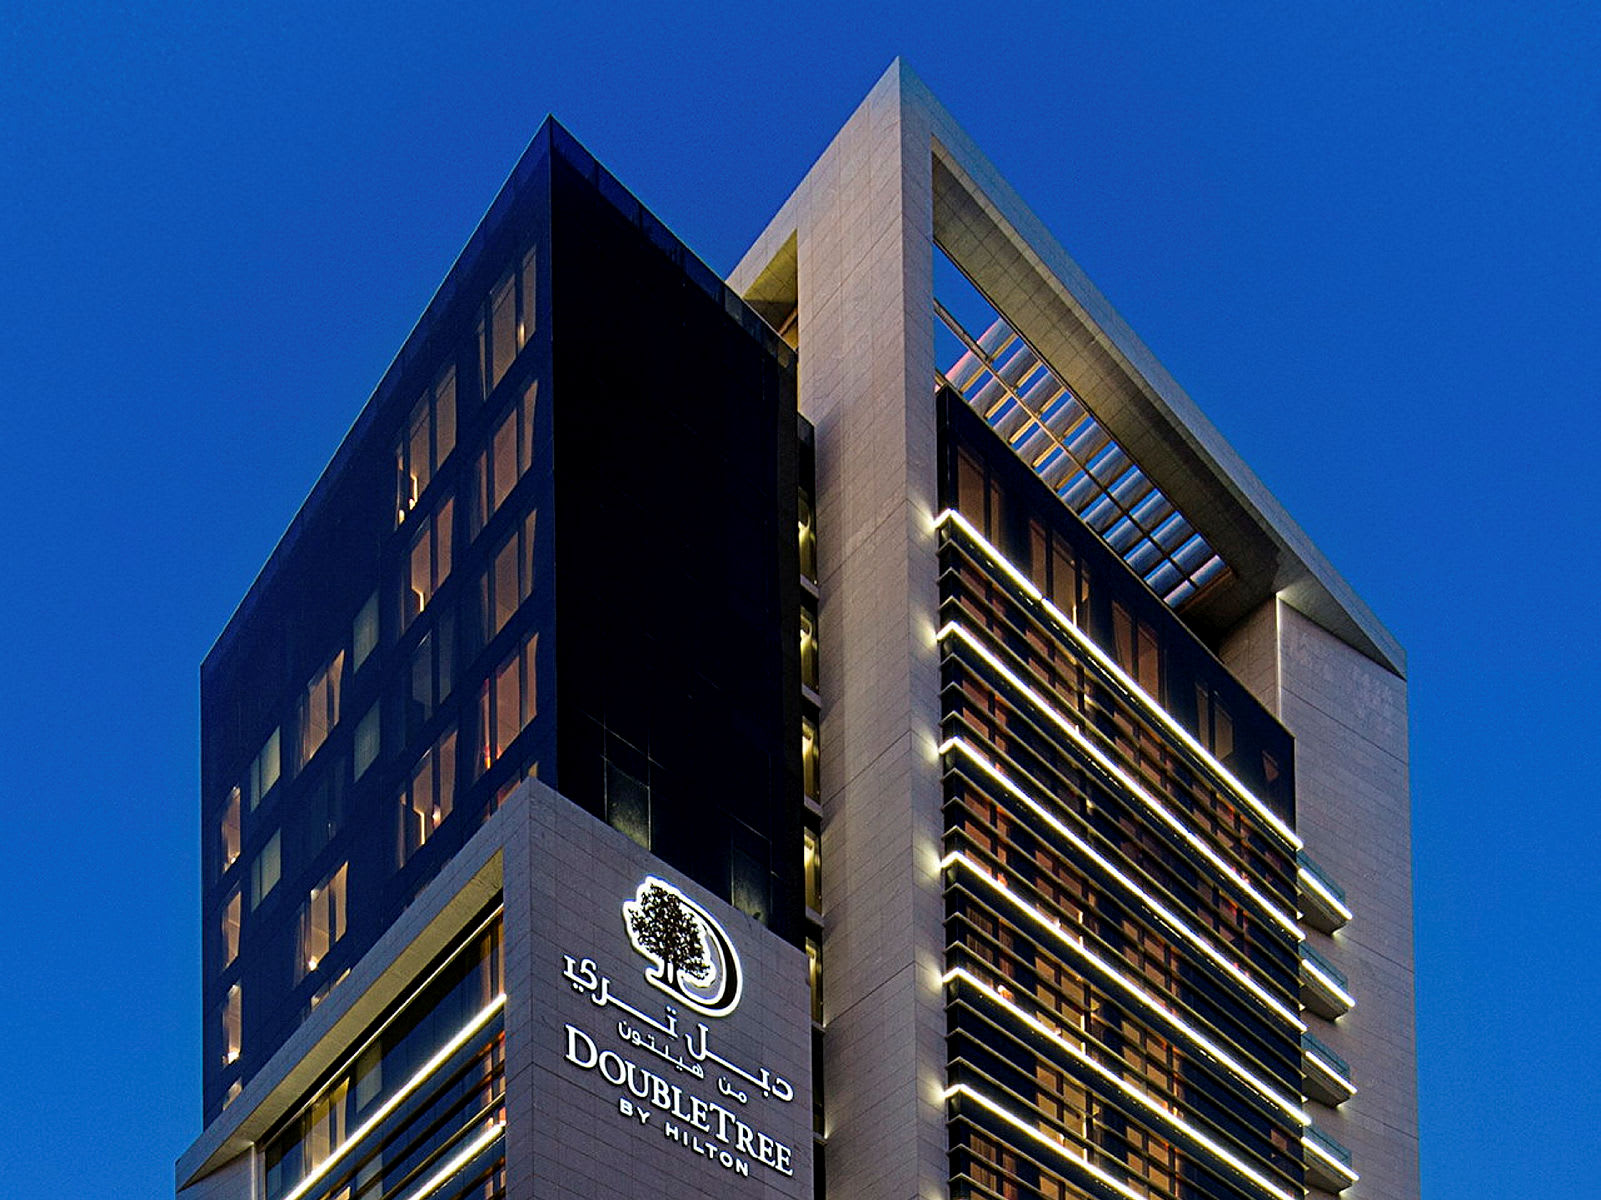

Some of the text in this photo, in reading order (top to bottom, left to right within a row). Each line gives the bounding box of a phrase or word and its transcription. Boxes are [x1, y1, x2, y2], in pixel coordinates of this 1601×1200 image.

[564, 1023, 794, 1177] DOUBLETREE
[618, 1020, 748, 1104] من هيلتون
[618, 1097, 749, 1178] BY HILTON
